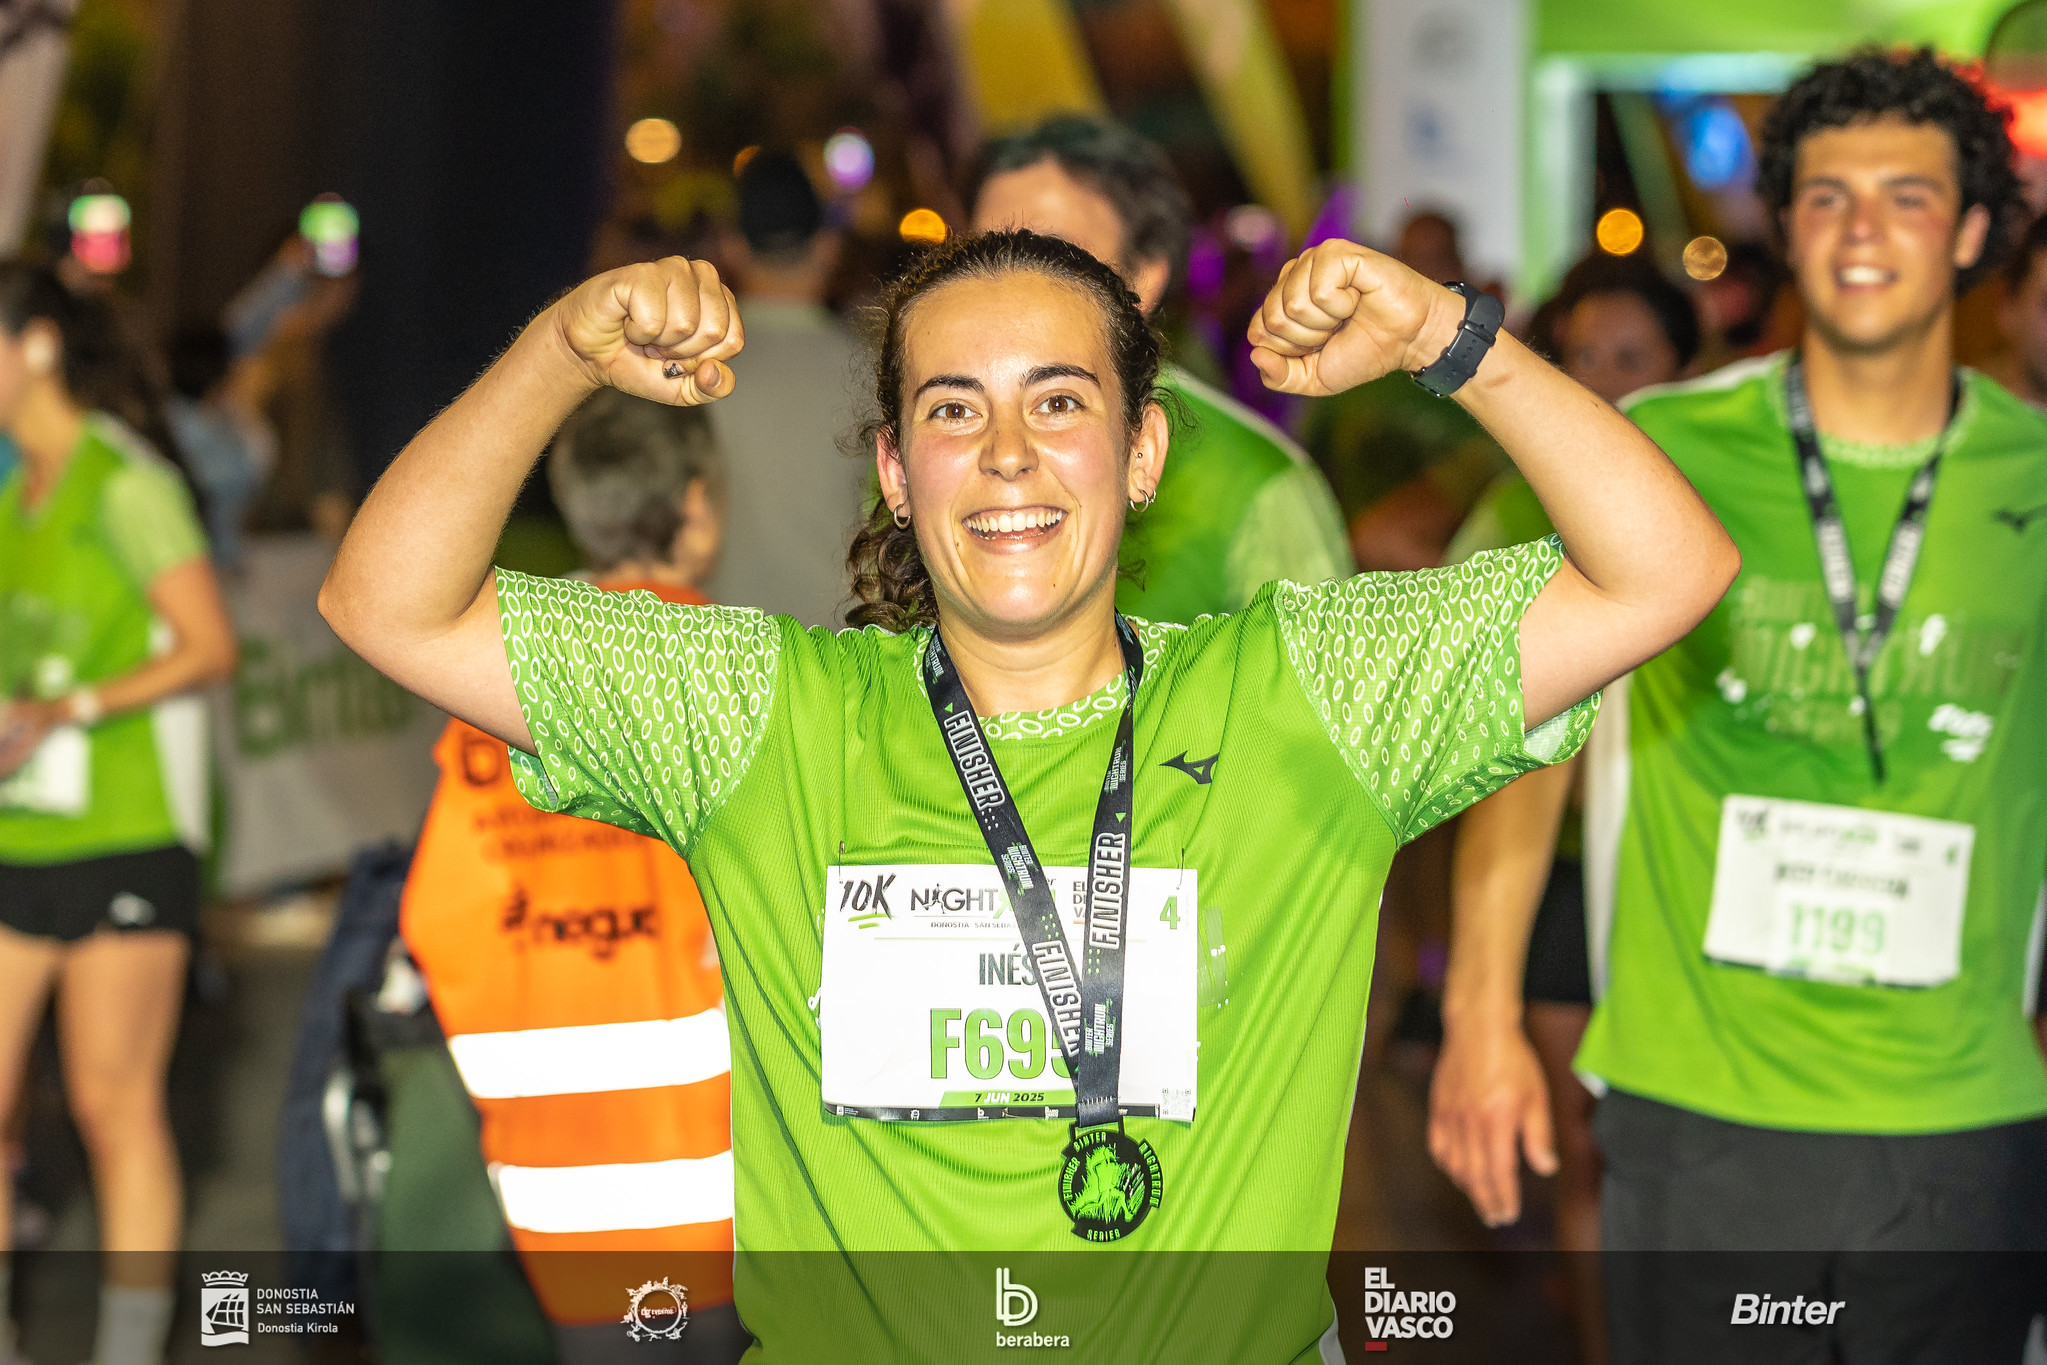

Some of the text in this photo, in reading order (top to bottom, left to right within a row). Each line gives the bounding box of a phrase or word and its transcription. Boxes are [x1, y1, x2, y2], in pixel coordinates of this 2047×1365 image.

[943, 710, 1005, 811] FINISHER
[1007, 846, 1034, 890] NIGHTRUN
[840, 873, 896, 920] 10K
[1089, 832, 1125, 950] FINISHER
[1160, 896, 1181, 930] 4
[979, 943, 1038, 986] INÉS
[975, 1092, 1045, 1104] 7 JUN 2025
[1073, 1131, 1106, 1152] BINTER
[1139, 1142, 1161, 1208] NIGHTRUN
[1087, 1228, 1121, 1241] SERIES
